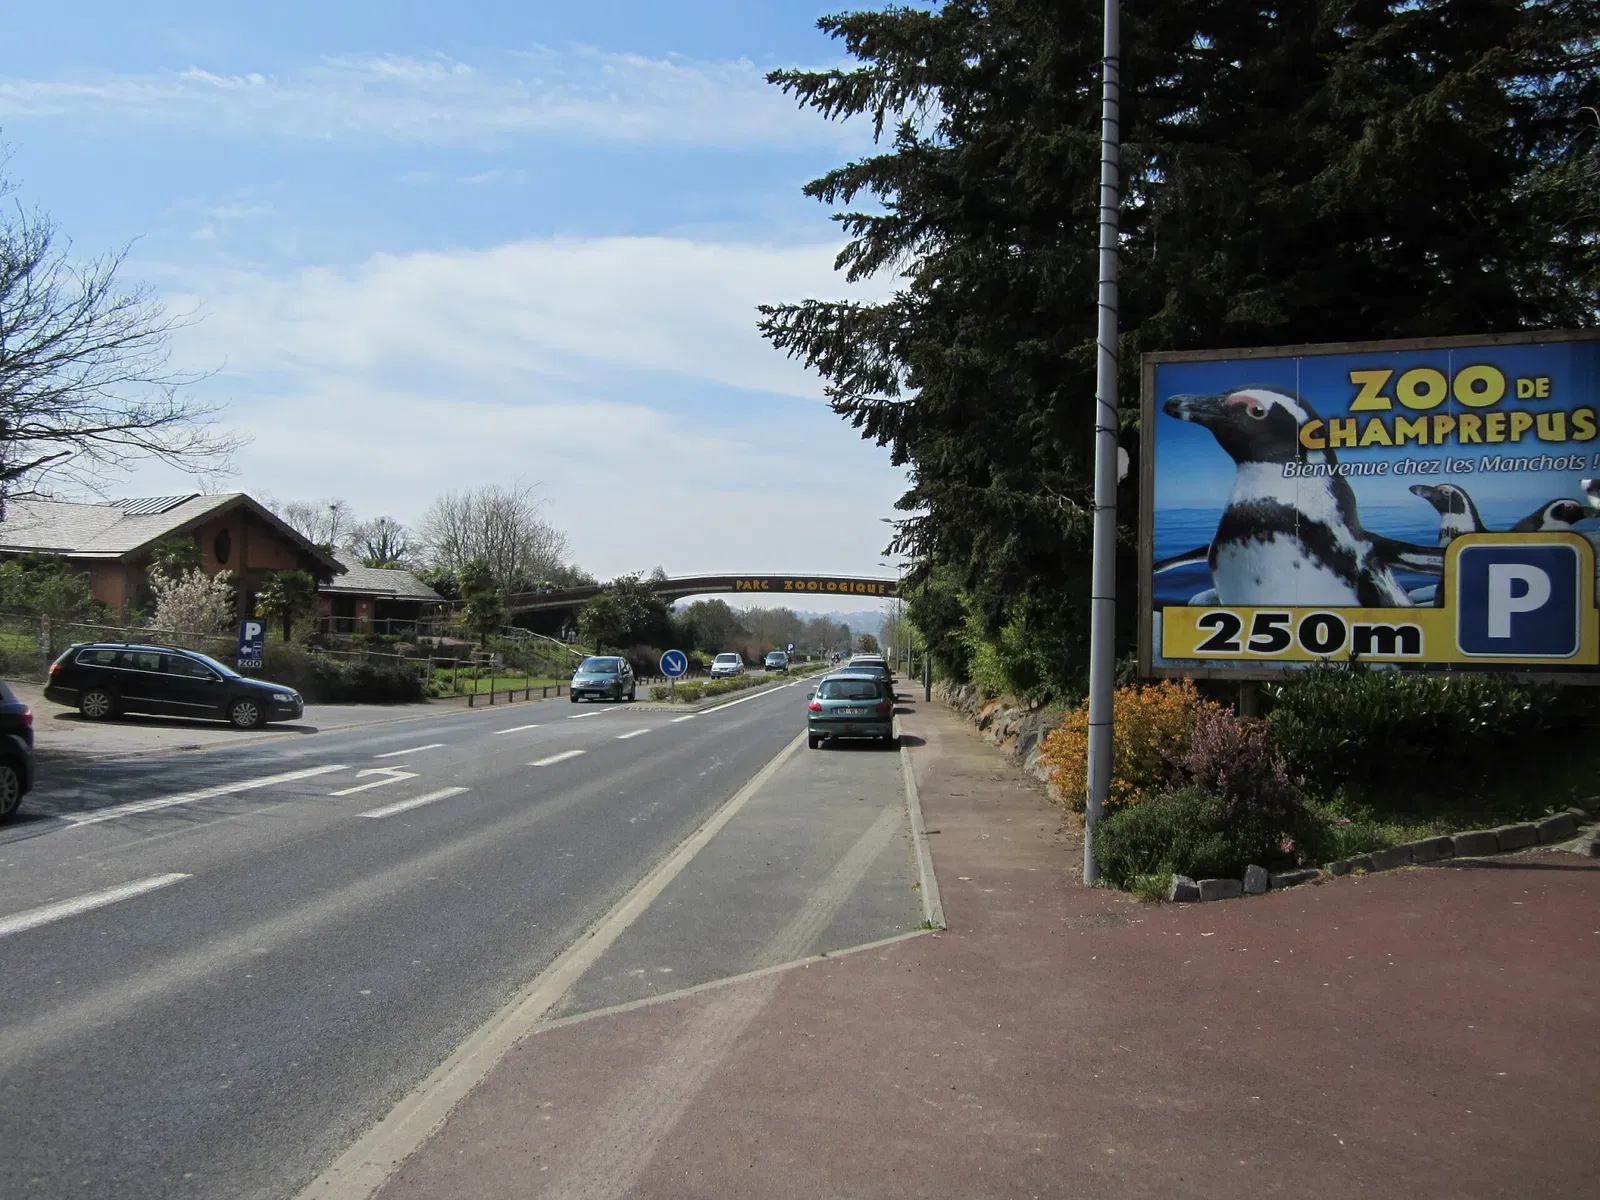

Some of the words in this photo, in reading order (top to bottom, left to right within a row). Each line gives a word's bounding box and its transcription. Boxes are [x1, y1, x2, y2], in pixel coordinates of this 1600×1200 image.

[1349, 365, 1506, 411] ZOO
[1516, 377, 1550, 399] DE
[1299, 408, 1598, 449] CHAMPREPUS
[1283, 461, 1389, 478] Bienvenue
[1393, 457, 1441, 475] chez
[1445, 456, 1475, 474] les
[1479, 453, 1586, 472] Manchots
[736, 579, 769, 590] PARC
[783, 580, 885, 594] ZOOLOGIQUE
[1487, 563, 1552, 639] P
[245, 622, 261, 640] P
[787, 643, 794, 651] P
[1195, 612, 1422, 655] 250m
